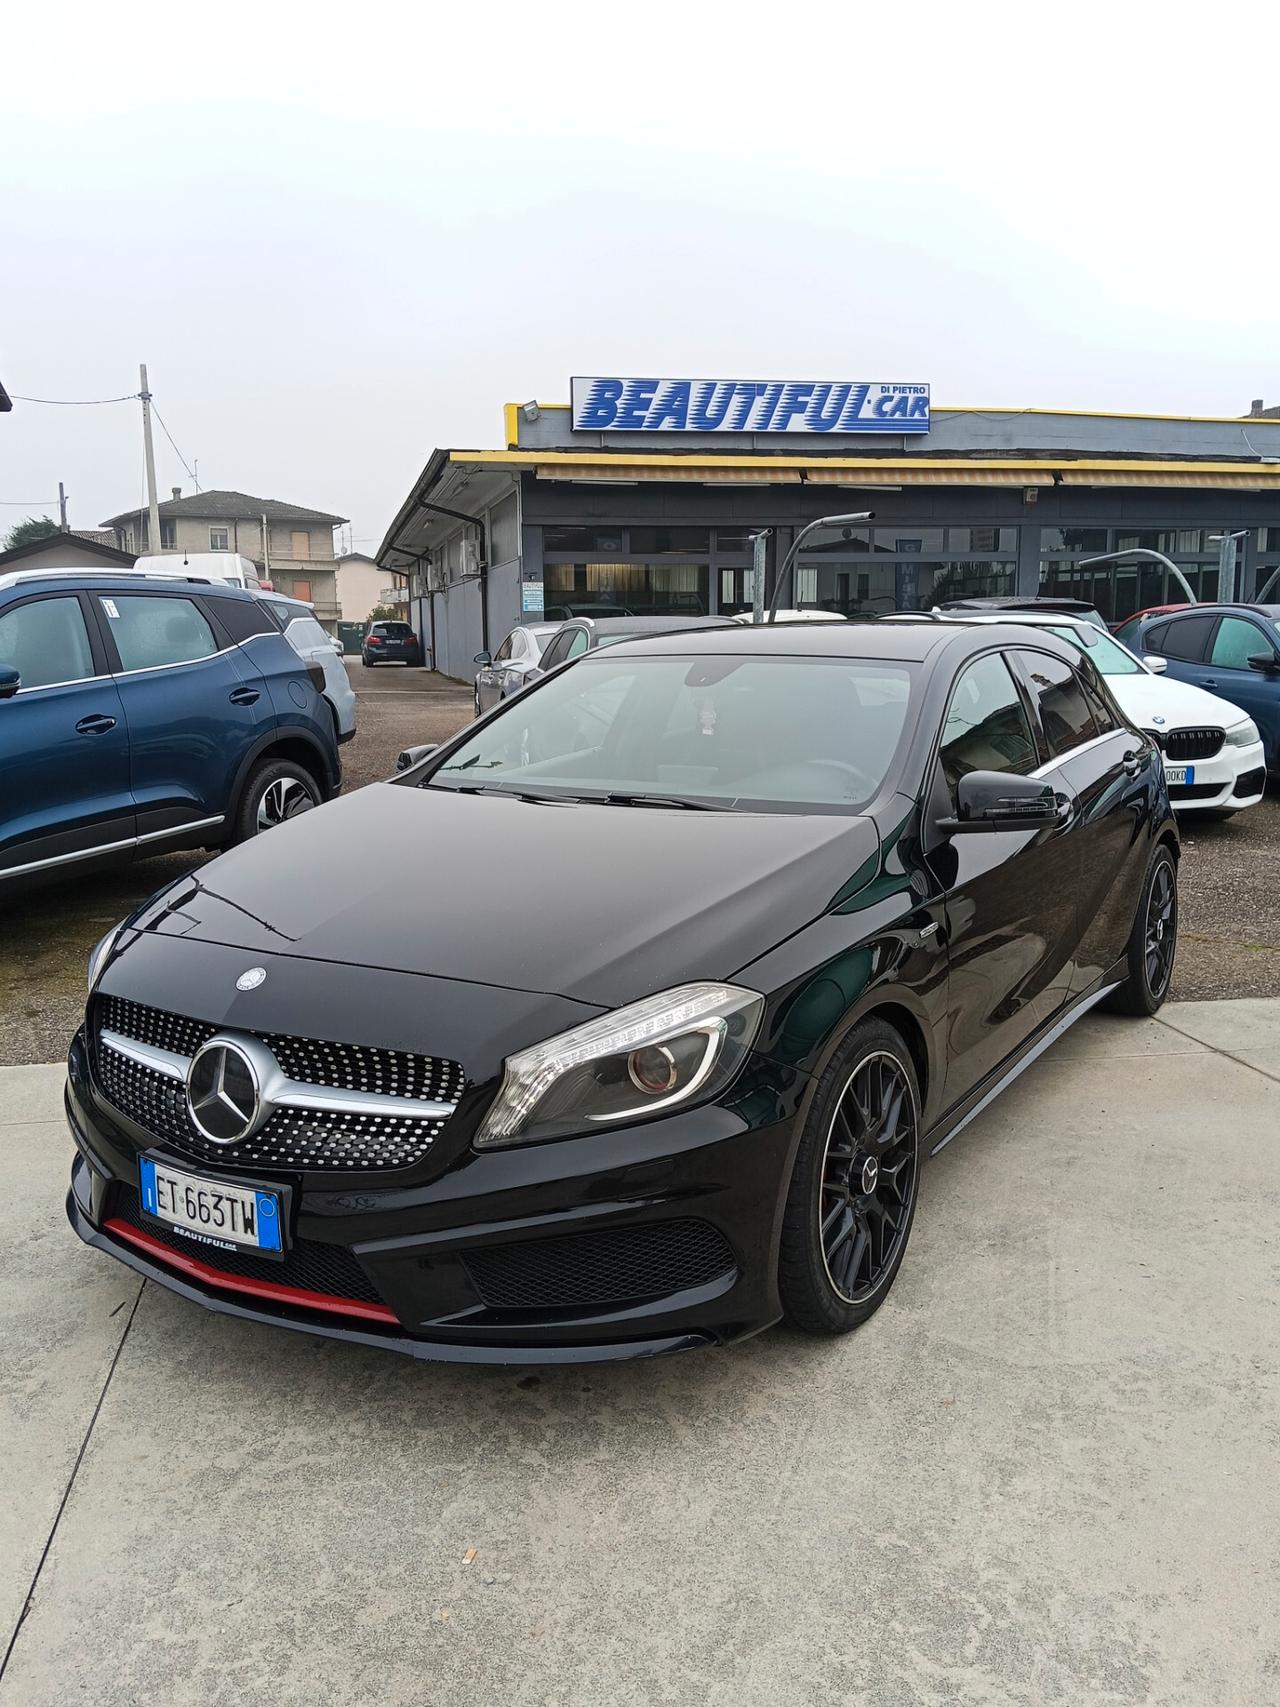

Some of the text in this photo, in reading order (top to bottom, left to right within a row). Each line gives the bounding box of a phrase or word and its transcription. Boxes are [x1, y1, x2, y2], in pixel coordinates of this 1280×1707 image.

[881, 386, 926, 394] DI PIETRO
[576, 379, 871, 431] BEAUTIFUL
[872, 396, 929, 418] CAR
[156, 1175, 256, 1236] ET 663TW
[173, 1226, 226, 1248] BEAUTIFUL
